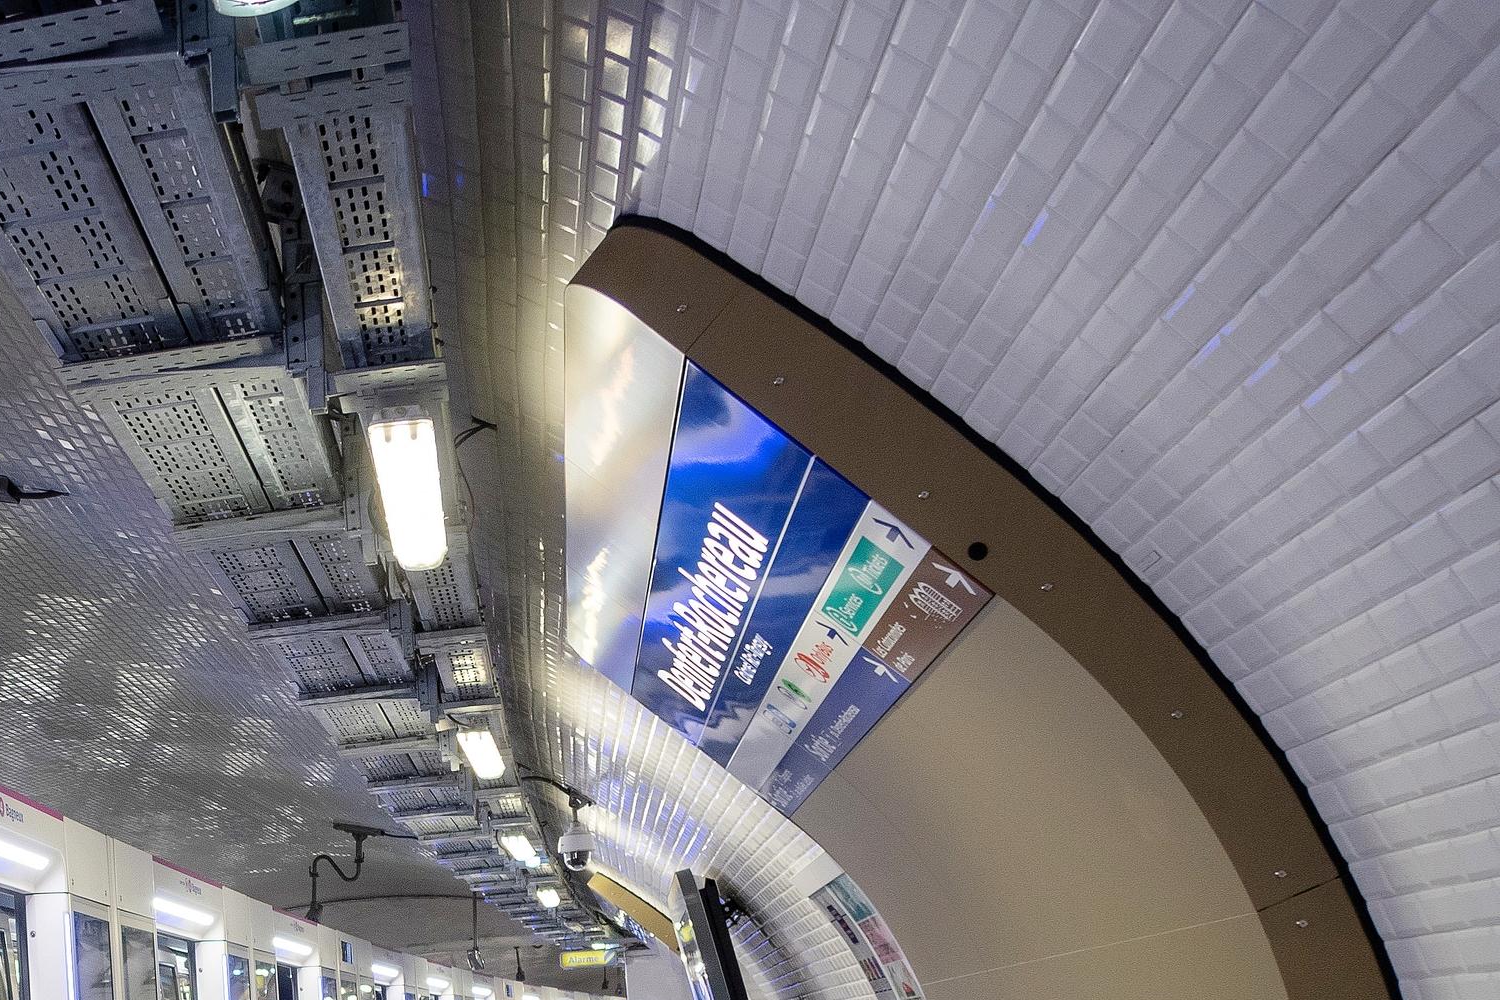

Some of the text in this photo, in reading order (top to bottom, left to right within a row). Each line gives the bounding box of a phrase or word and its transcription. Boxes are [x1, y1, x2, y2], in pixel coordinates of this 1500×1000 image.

[657, 501, 769, 712] Denfert-Rochereau
[839, 593, 864, 619] Services
[804, 733, 836, 762] Sortie
[569, 955, 598, 964] Alarme
